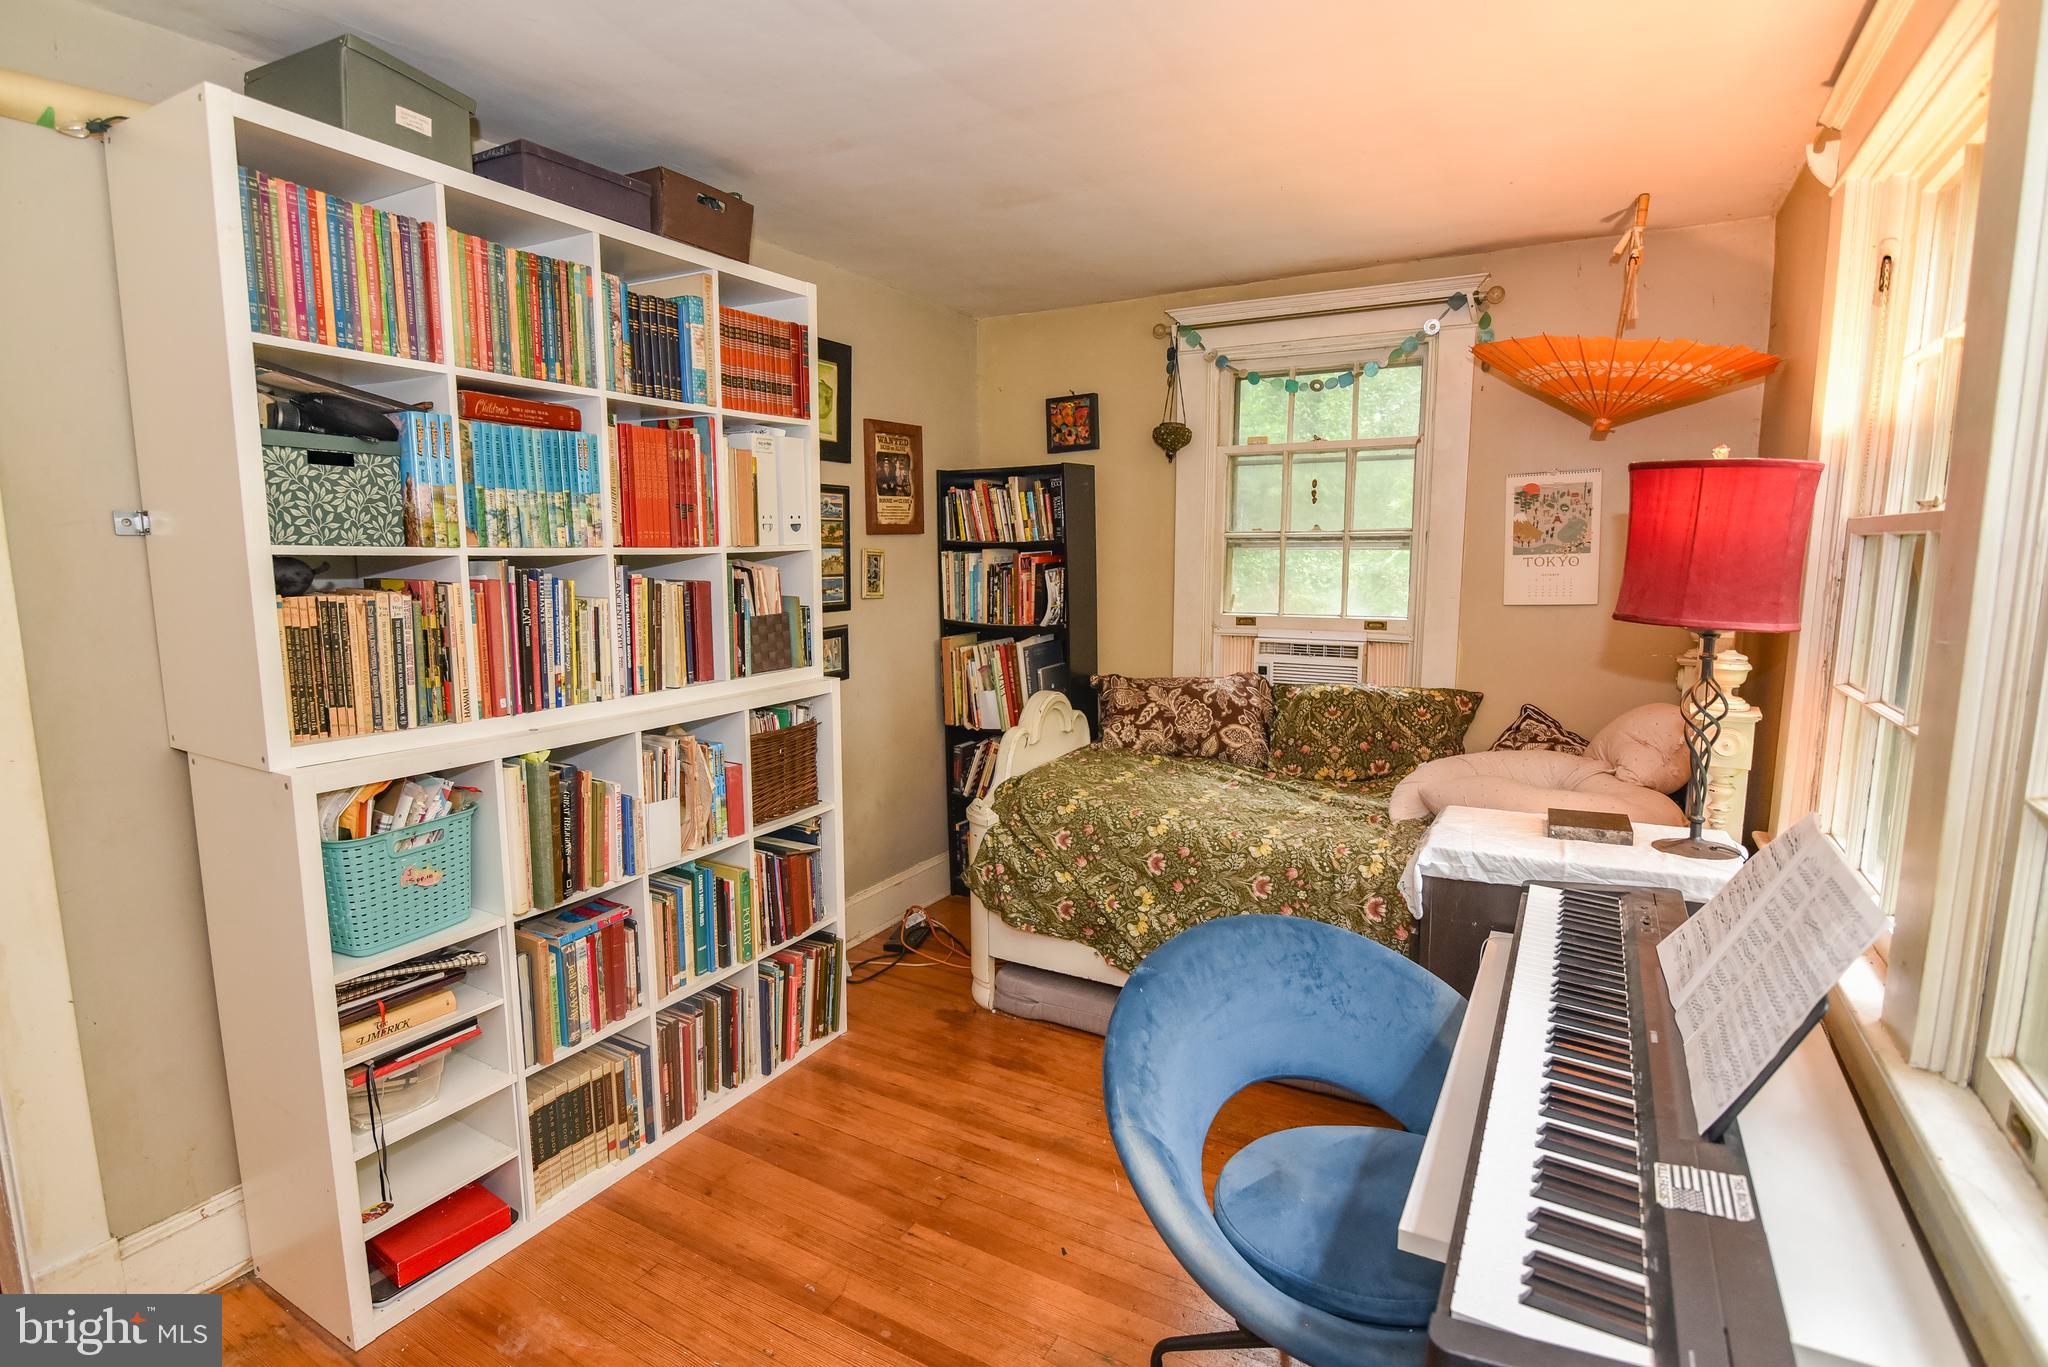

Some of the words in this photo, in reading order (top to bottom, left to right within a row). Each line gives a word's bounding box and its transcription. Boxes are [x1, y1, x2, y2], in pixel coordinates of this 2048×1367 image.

[877, 435, 909, 446] WANTED
[1522, 556, 1580, 568] TOKYO
[614, 583, 622, 621] ANCIENT
[521, 608, 532, 626] CAT
[463, 688, 471, 718] HAWAII
[562, 791, 572, 815] GREAT
[742, 907, 751, 945] POETRY
